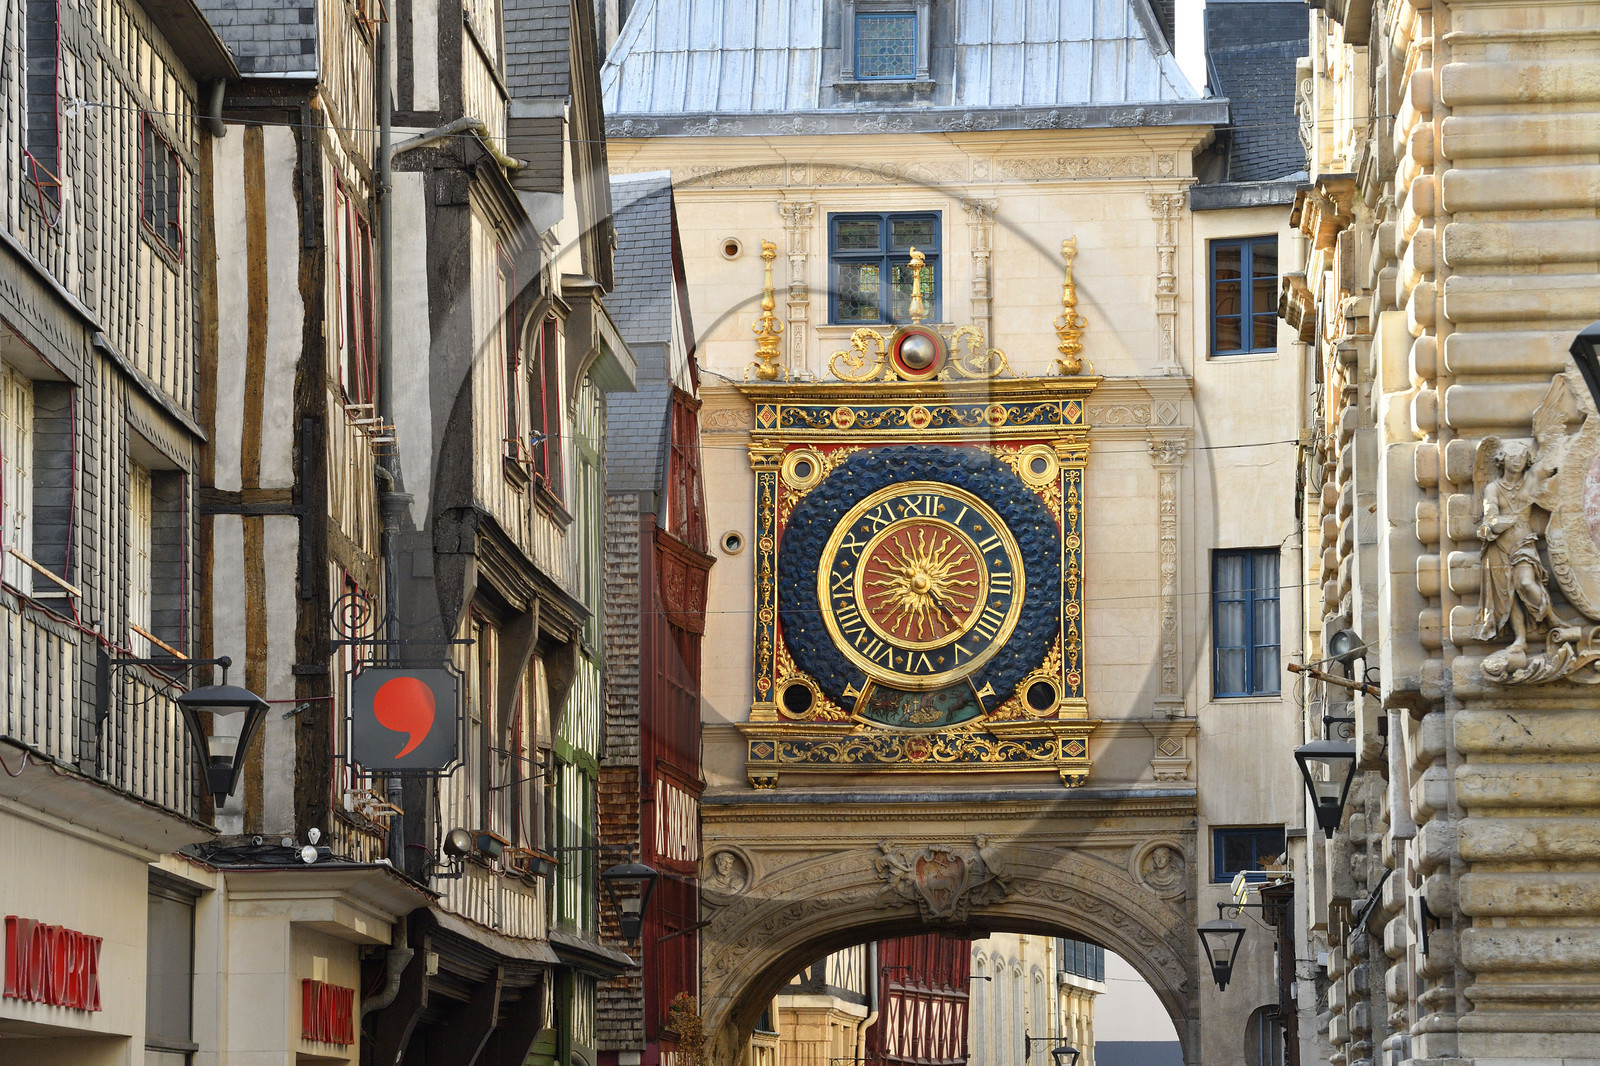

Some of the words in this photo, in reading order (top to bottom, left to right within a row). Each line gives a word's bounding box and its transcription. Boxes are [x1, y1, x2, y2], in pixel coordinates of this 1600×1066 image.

[864, 502, 898, 535] XI
[902, 495, 940, 518] XII
[954, 506, 968, 525] I
[840, 532, 867, 558] X
[978, 534, 1003, 554] II
[832, 570, 854, 599] IX
[990, 571, 1012, 596] III
[836, 603, 867, 648] VIII
[973, 605, 1006, 641] IIII
[862, 636, 895, 670] VII
[905, 651, 936, 673] VI
[954, 643, 975, 666] V
[4, 915, 103, 1012] MONOPRIX
